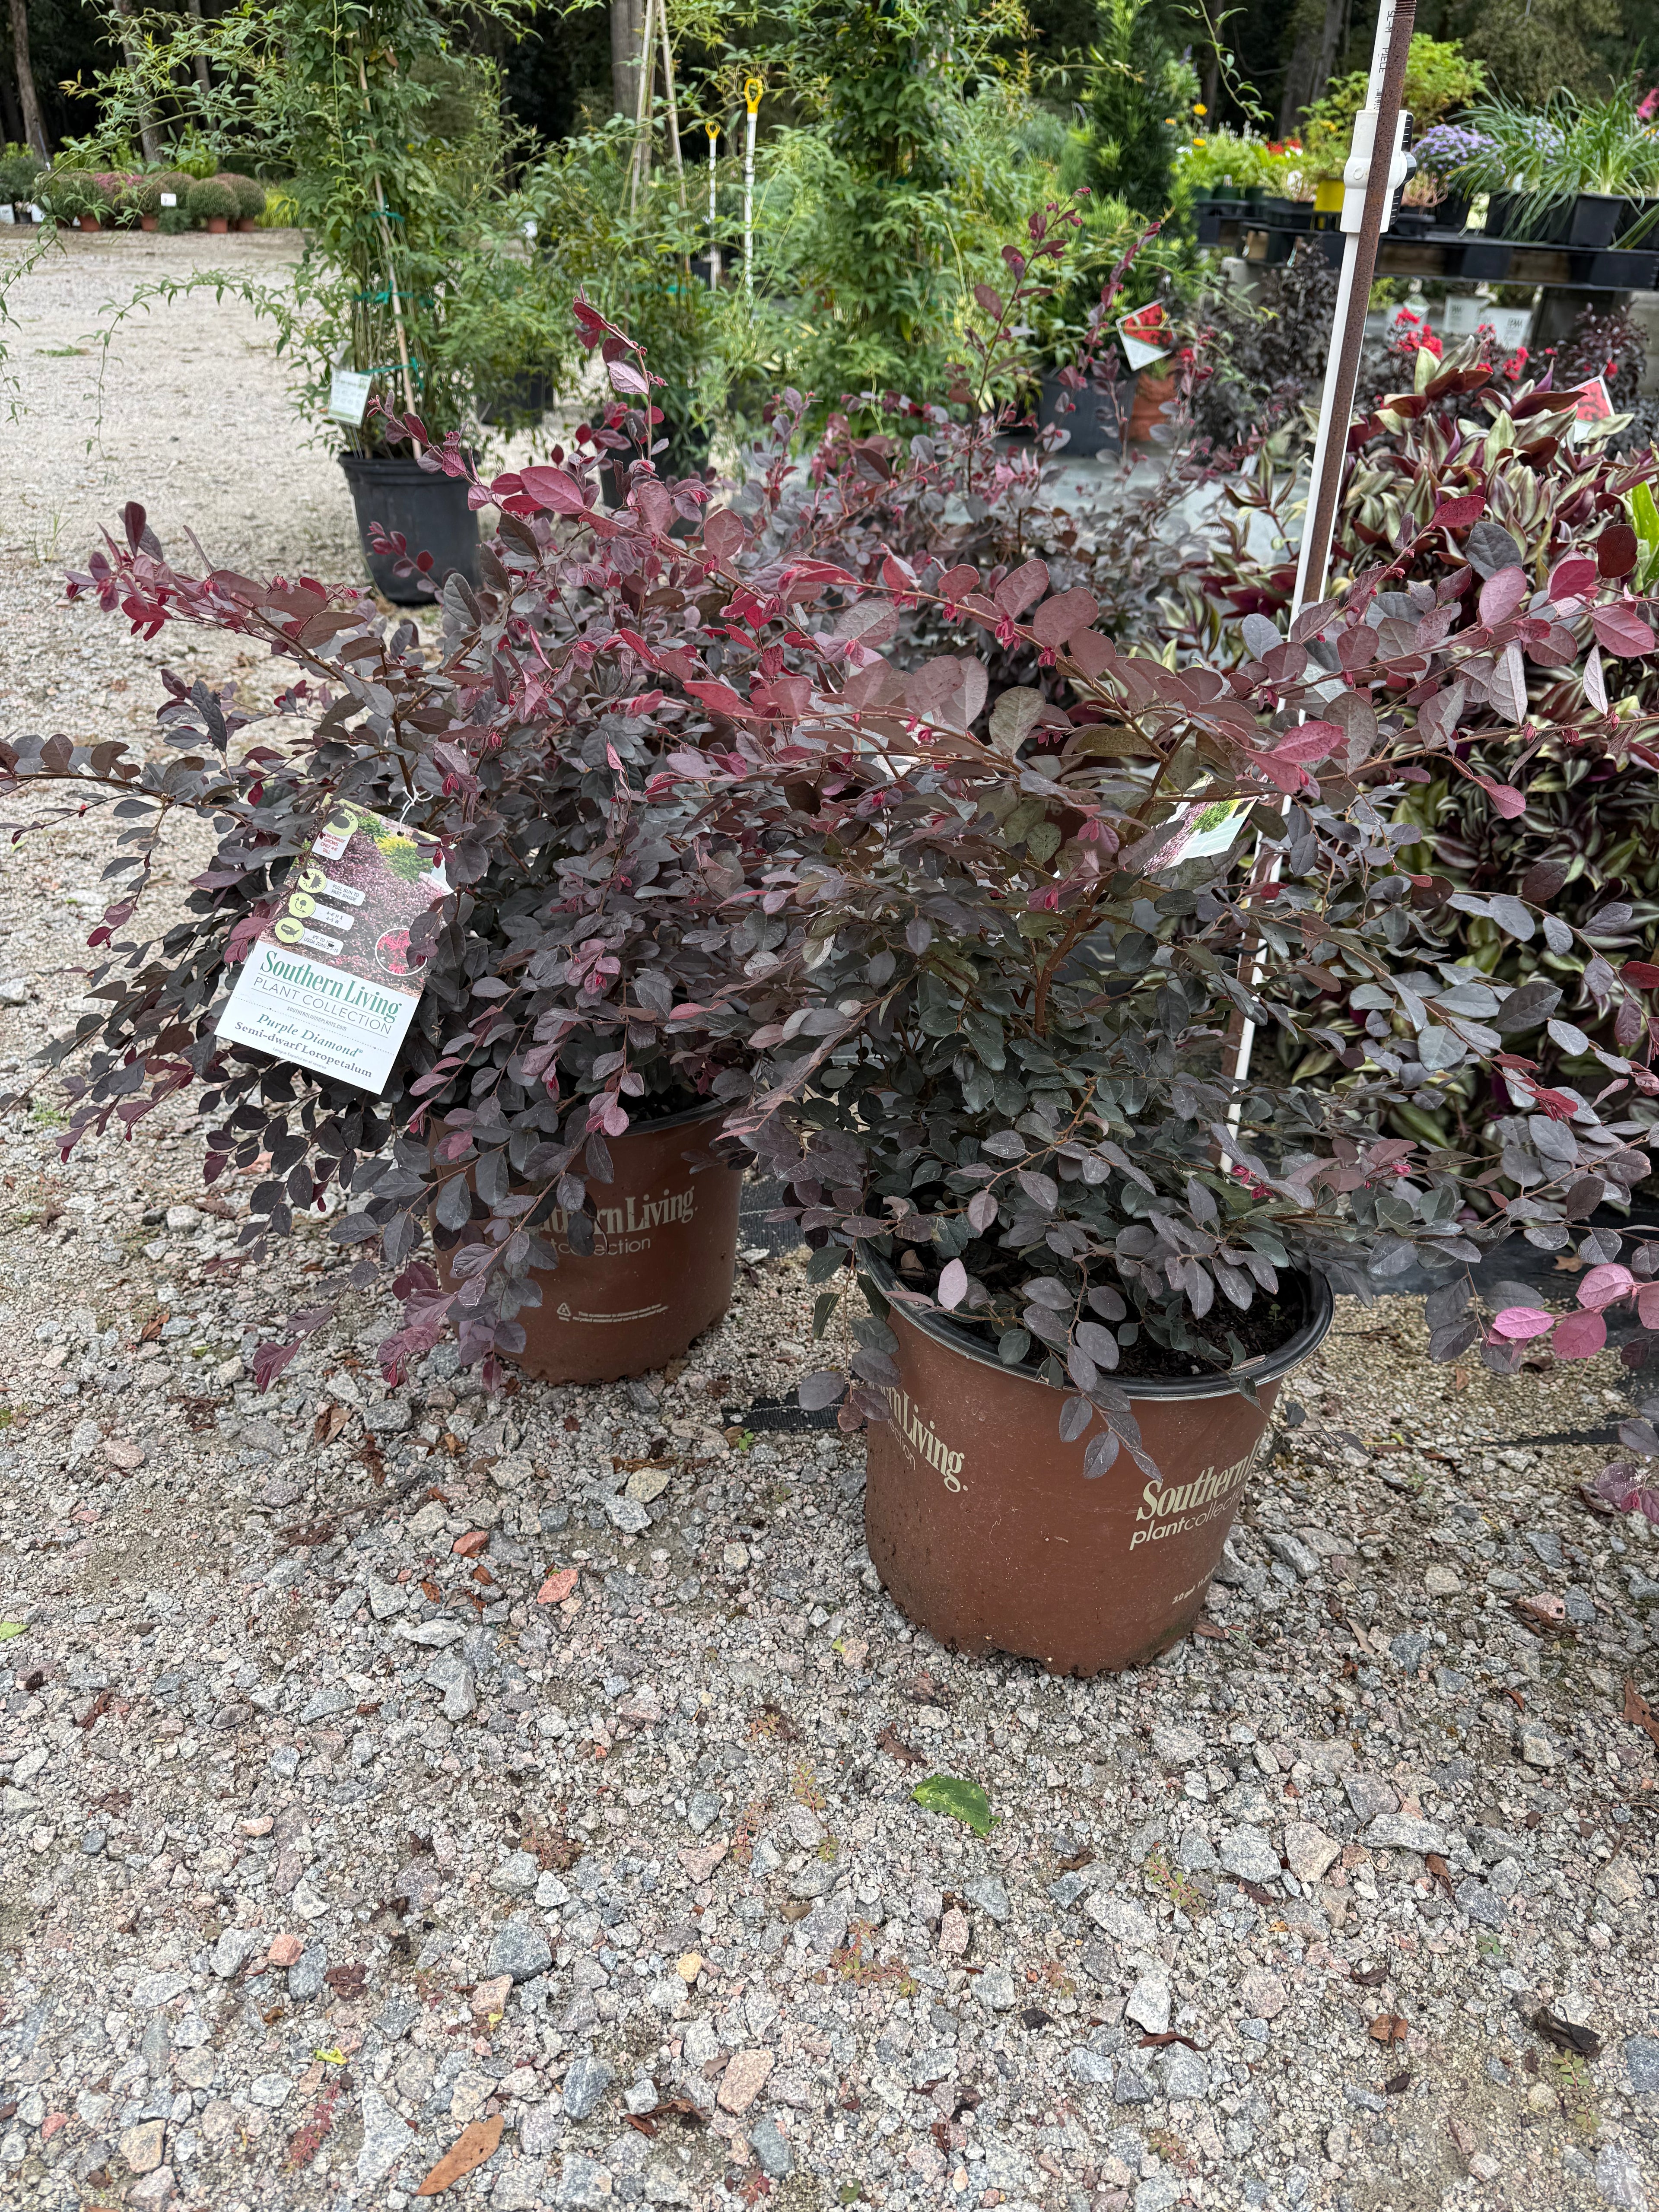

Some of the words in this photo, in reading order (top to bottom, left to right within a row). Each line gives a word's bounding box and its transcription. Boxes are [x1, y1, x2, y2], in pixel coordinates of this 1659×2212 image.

[324, 838, 339, 847] GROWS
[342, 893, 357, 902] SHADE
[315, 941, 329, 950] ZONES
[260, 950, 343, 998] Southern
[254, 977, 300, 1000] PLANT
[303, 995, 392, 1034] COLLECTION
[257, 1013, 299, 1036] Purple
[287, 1006, 347, 1032] SOUTHERNLIVINGPLANTS.COM
[235, 1022, 303, 1051] Semi-dwarf
[301, 1045, 372, 1077] Loropetalum
[273, 1047, 287, 1056] Lengua
[287, 1052, 303, 1061] Español
[1136, 1456, 1249, 1521] Southern
